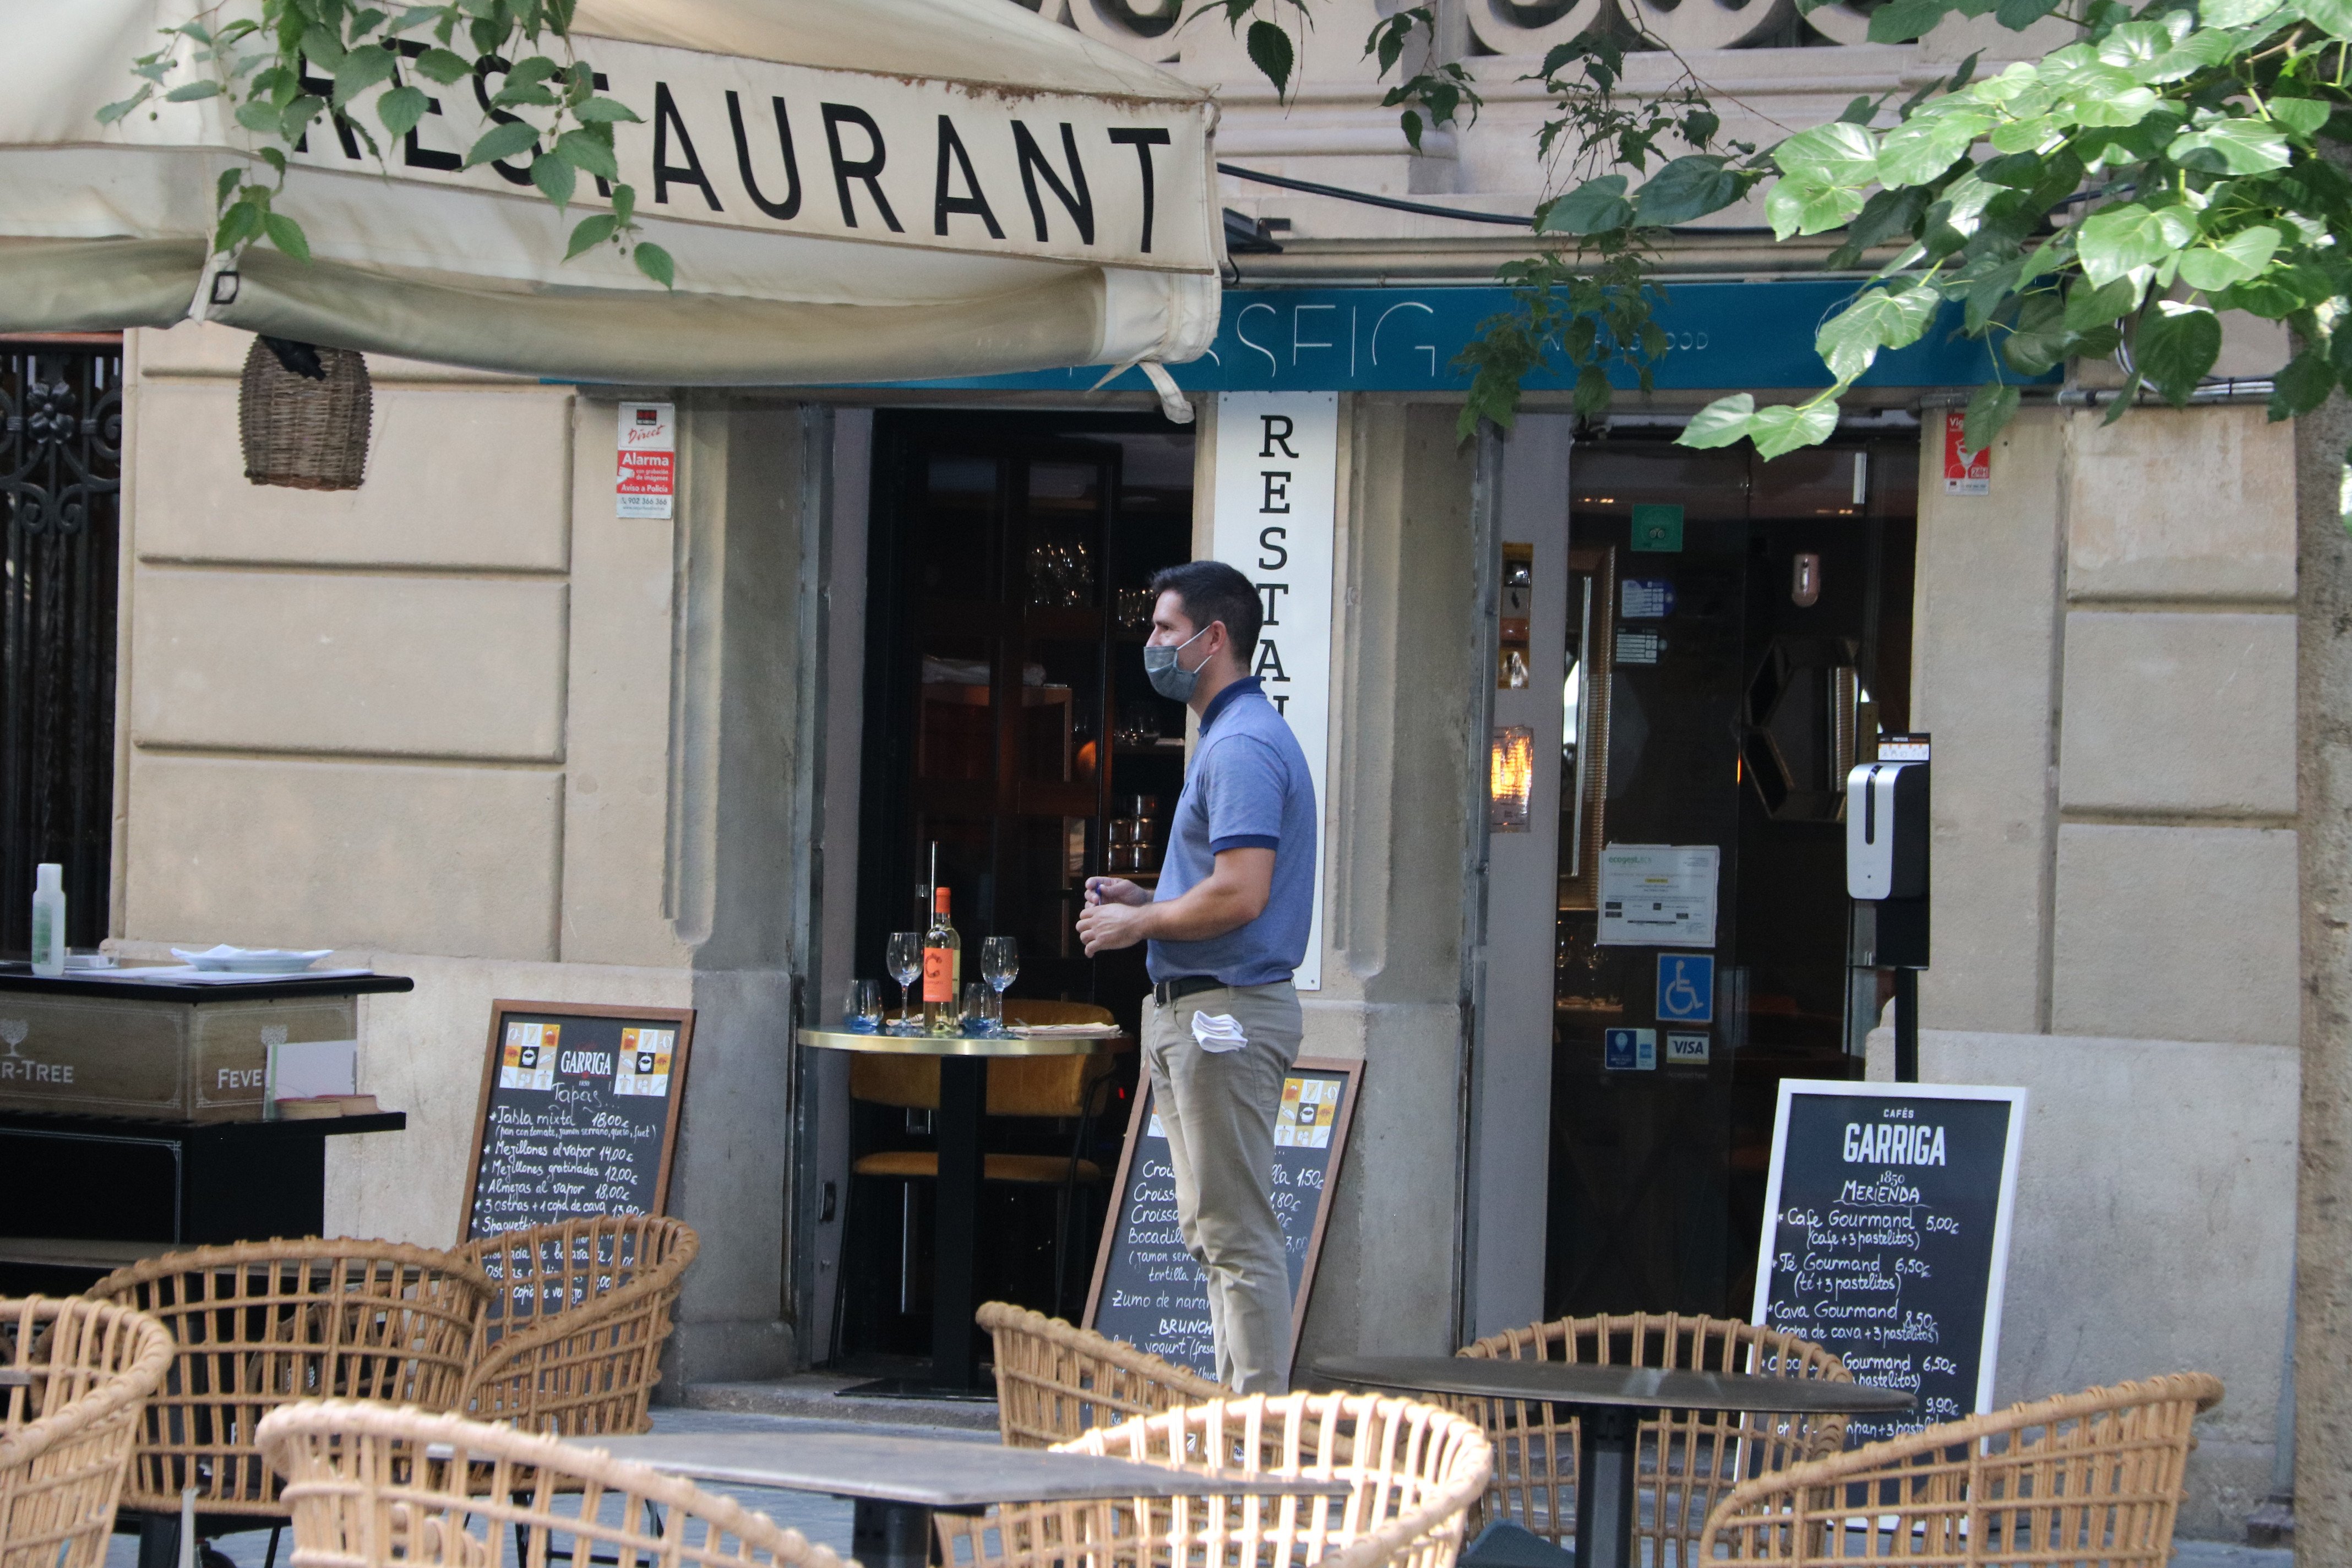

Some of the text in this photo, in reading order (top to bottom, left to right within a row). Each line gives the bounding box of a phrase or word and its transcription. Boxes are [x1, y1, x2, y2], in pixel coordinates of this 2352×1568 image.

[628, 424, 665, 444] Direct
[622, 452, 669, 467] Alarma
[1674, 1041, 1703, 1054] VISA
[560, 1050, 612, 1075] GARRIGA
[497, 1105, 533, 1125] Tabla
[536, 1109, 576, 1126] mixta
[1883, 1108, 1914, 1119] CAFÉS
[495, 1140, 548, 1163] Mejillones
[600, 1146, 634, 1163] 14,00€
[1843, 1123, 1946, 1166] GARRIGA
[492, 1159, 638, 1185] Mejillones gratinados 12,00€
[1296, 1167, 1324, 1190] 1,50€
[1879, 1170, 1905, 1187] 1850
[488, 1178, 630, 1204] Almejas al vapor 18,00€
[483, 1199, 492, 1213] 3
[496, 1193, 529, 1212] ostras
[540, 1201, 545, 1212] 1
[570, 1198, 581, 1211] de
[612, 1204, 645, 1218] 1390
[1828, 1207, 1915, 1230] Gourmand
[1925, 1215, 1960, 1235] 5,00€
[1849, 1232, 1856, 1245] 3
[1858, 1228, 1920, 1253] pastelitos)
[486, 1262, 522, 1278] Ostas
[1148, 1265, 1189, 1282] tortilla
[1779, 1251, 1932, 1278] Té Gourmand 6,50€
[1794, 1270, 1814, 1299] (té
[1825, 1277, 1833, 1293] 3
[1835, 1272, 1901, 1302] pastelitos)
[1112, 1289, 1151, 1308] Zumo
[1156, 1289, 1170, 1308] de
[1774, 1300, 1810, 1320] Cava
[1814, 1298, 1899, 1320] Gourmand
[1158, 1317, 1215, 1336] BRUNCH
[1811, 1323, 1827, 1340] de
[1831, 1326, 1862, 1340] cava
[1874, 1326, 1881, 1341] 3
[1145, 1337, 1186, 1358] yogurt
[1842, 1352, 1910, 1371] Gourmand
[1923, 1355, 1957, 1375] 6,50€
[1925, 1396, 1959, 1416] 9,90€
